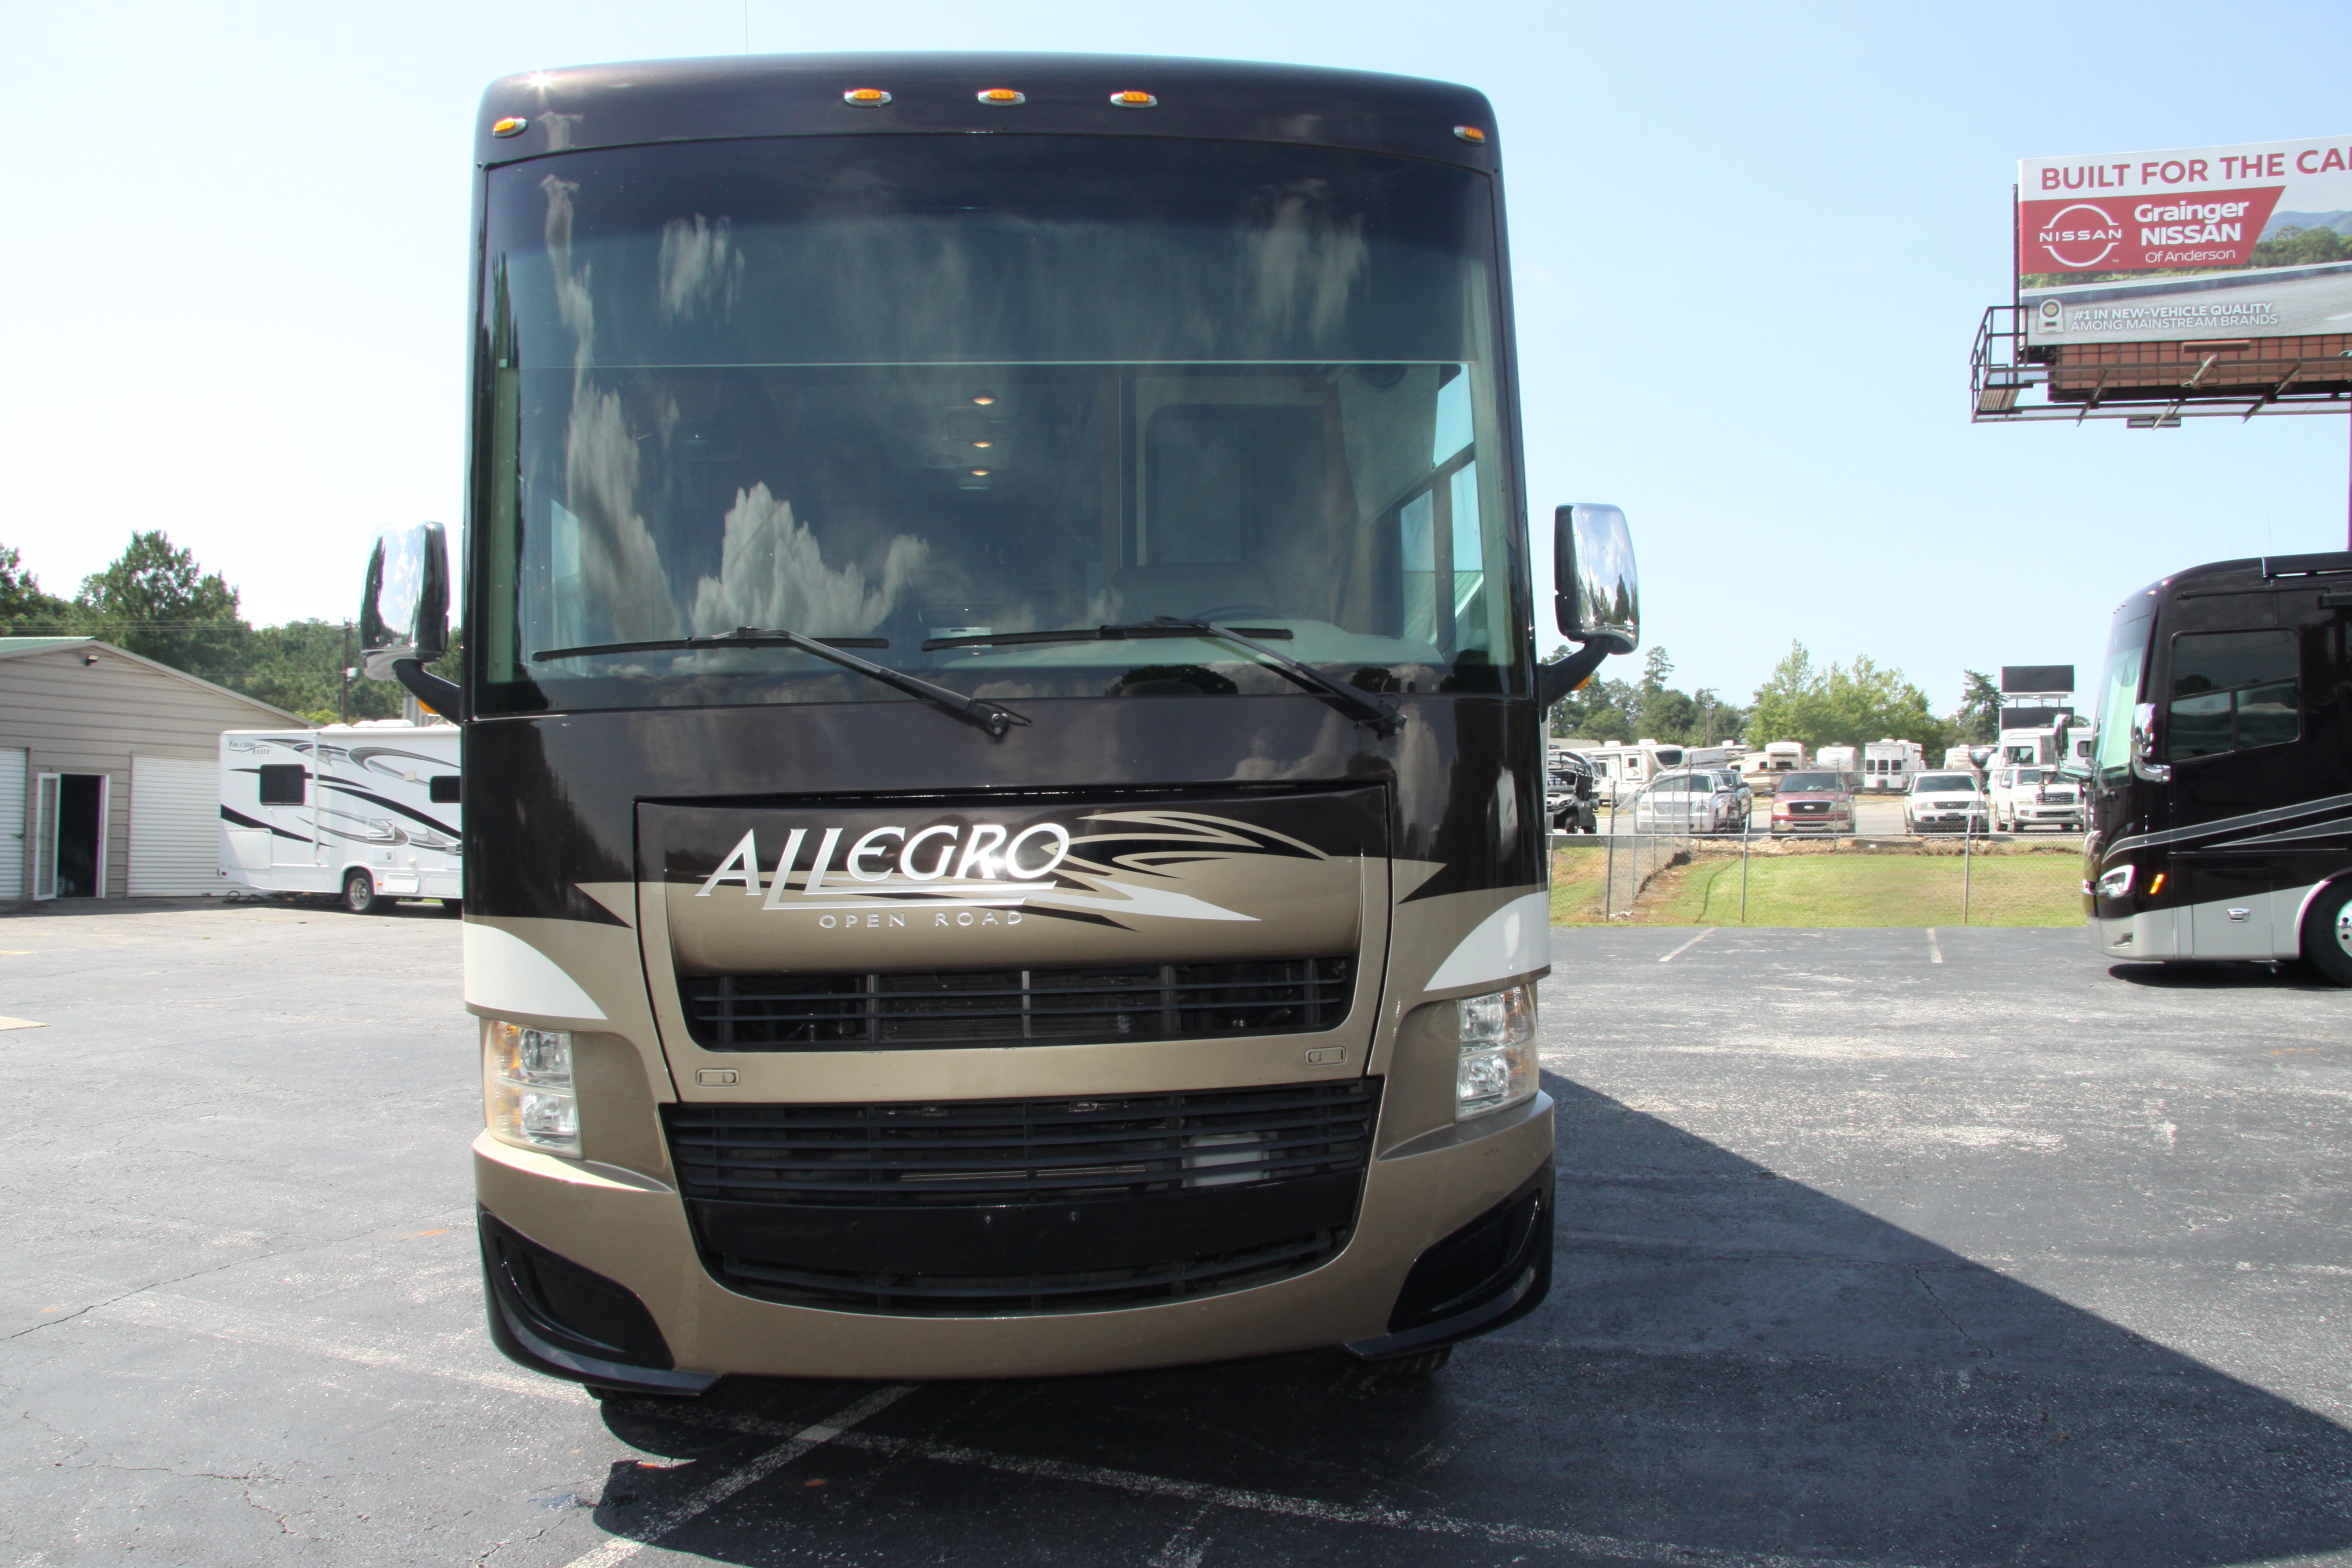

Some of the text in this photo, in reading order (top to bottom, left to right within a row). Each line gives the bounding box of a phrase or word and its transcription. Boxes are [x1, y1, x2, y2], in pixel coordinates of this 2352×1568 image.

[2041, 146, 2352, 190] BUILT FOR THE CA
[2134, 200, 2250, 224] Grainger
[2039, 229, 2122, 242] NISSAN
[2141, 223, 2241, 246] NISSAN
[2145, 250, 2236, 263] Of Anderson
[2073, 302, 2273, 321] #1 IN NEW-VEHICLE QUALITY
[2070, 314, 2278, 332] AMONG MAINSTREAM BRANDS
[695, 823, 1070, 910] ALLEGRO
[818, 909, 1023, 929] OPEN ROAD
